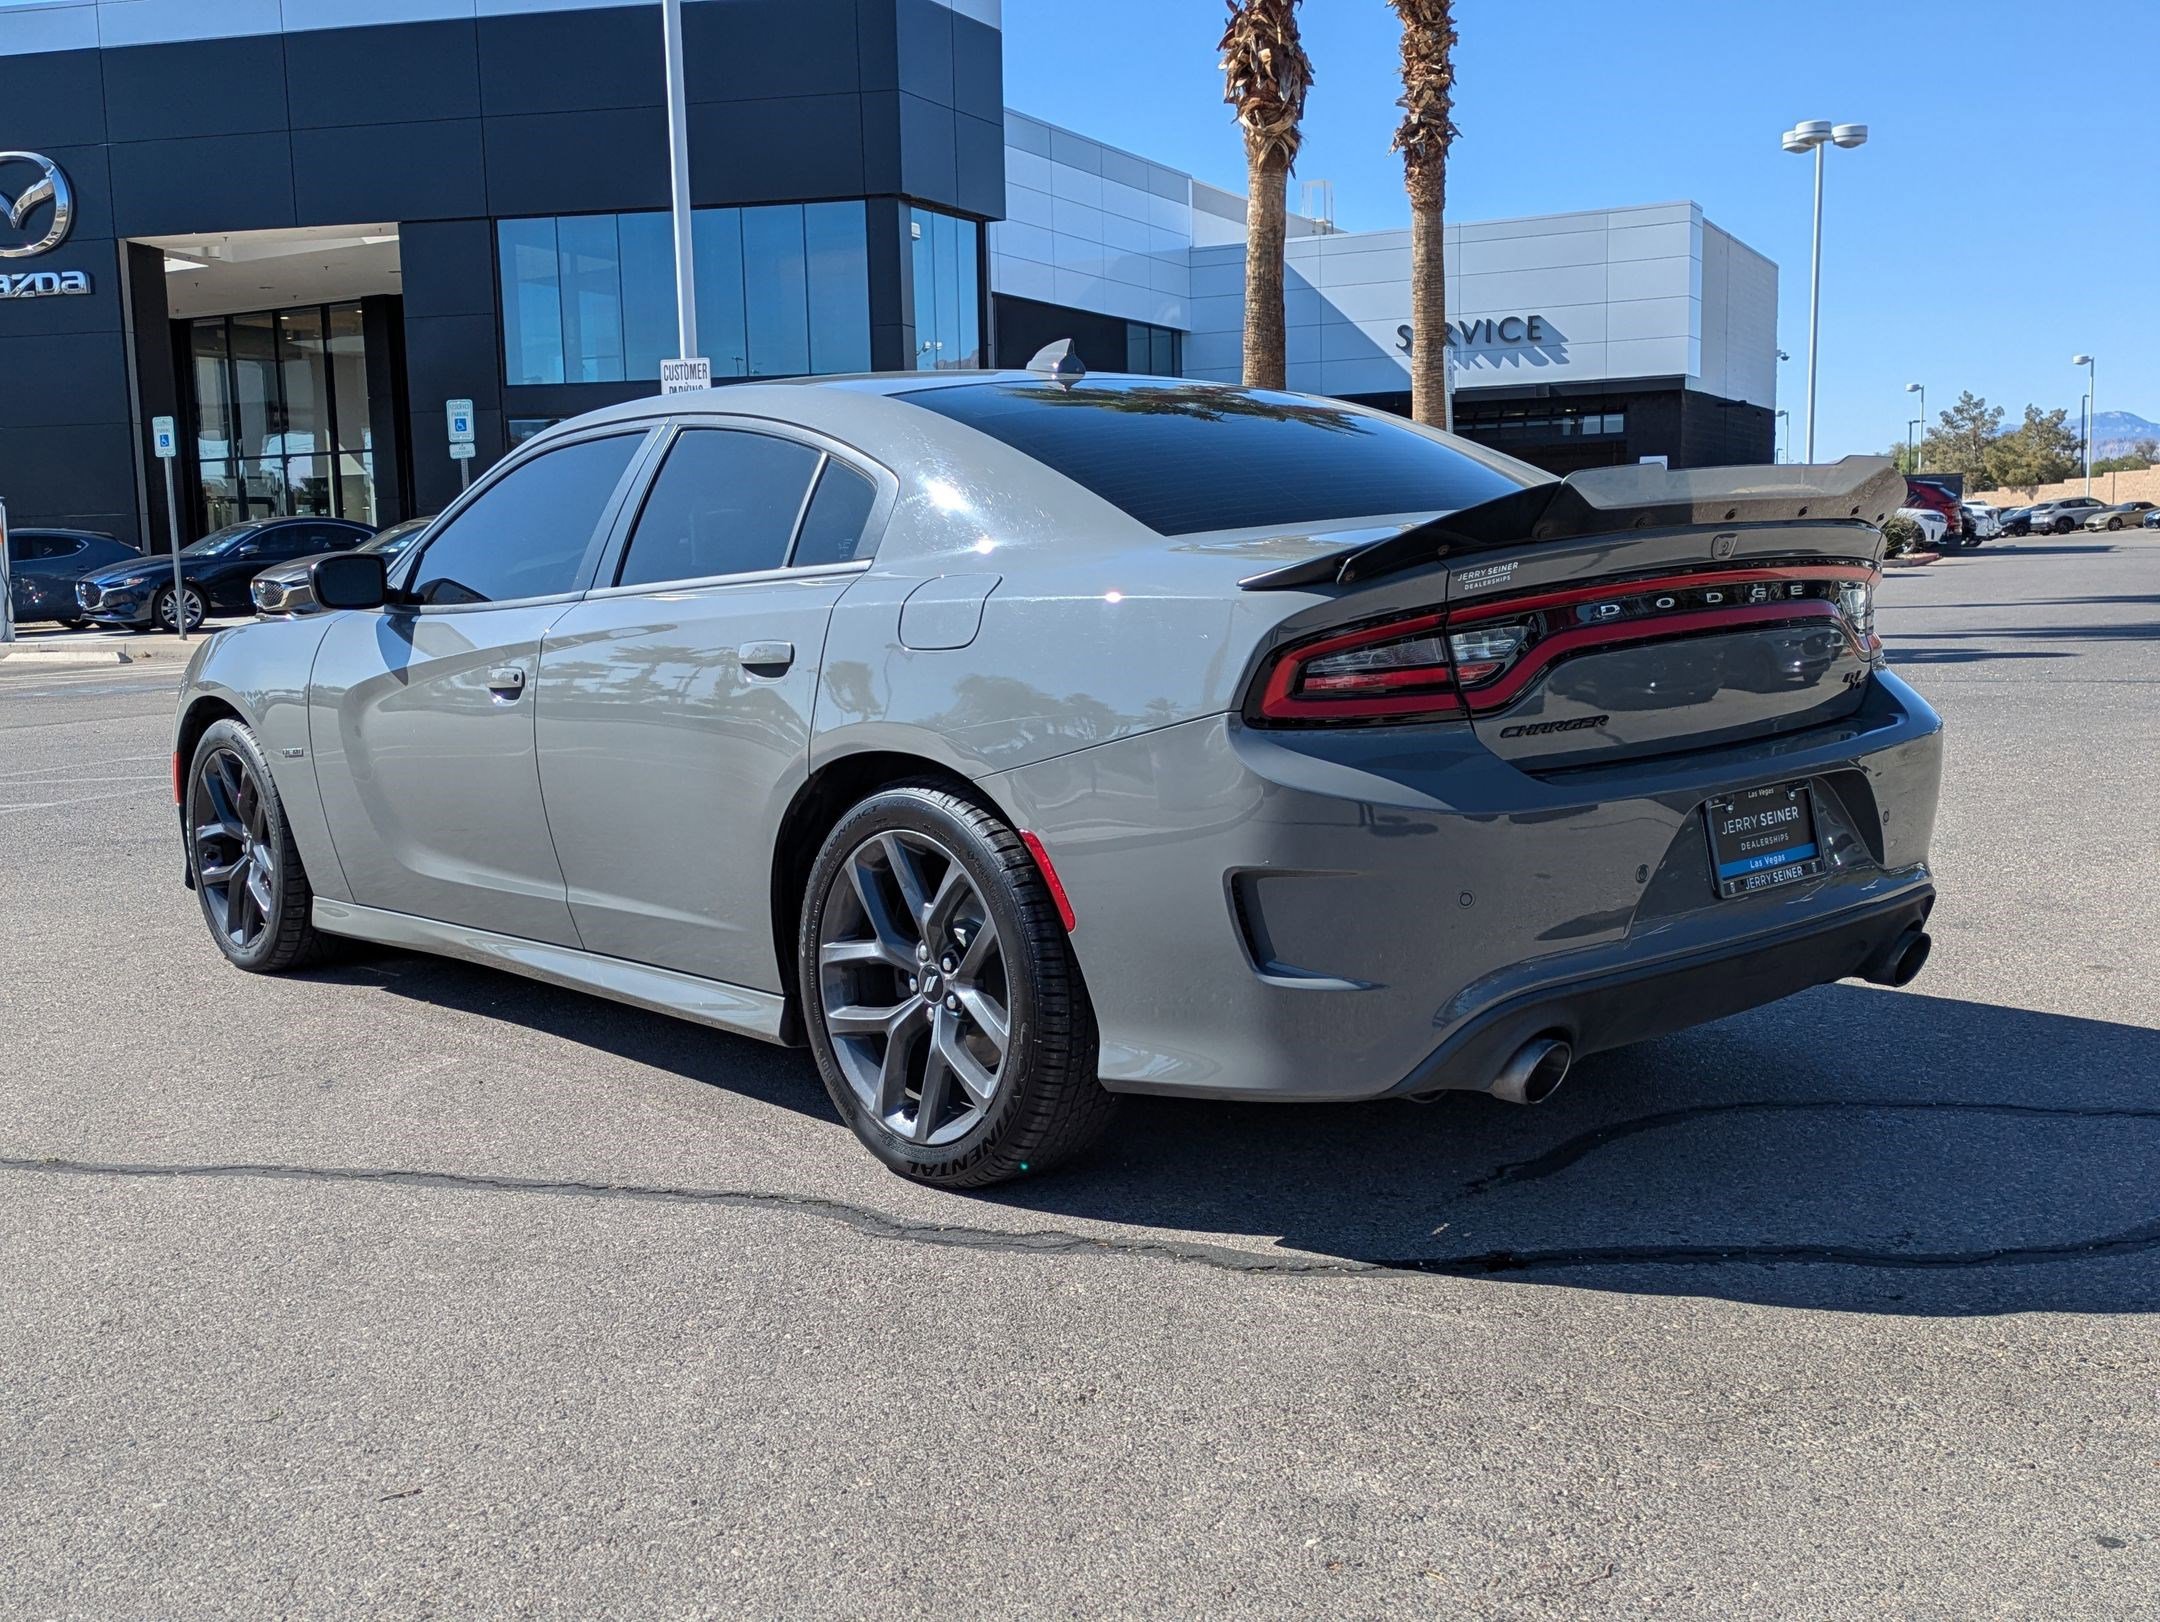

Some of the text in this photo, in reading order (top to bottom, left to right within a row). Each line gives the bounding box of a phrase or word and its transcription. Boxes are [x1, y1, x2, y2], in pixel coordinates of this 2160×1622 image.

[1396, 315, 1542, 351] SRVICE
[663, 362, 708, 382] CUSTOMER
[1457, 561, 1519, 582] JERRY SEINER
[1464, 575, 1511, 591] DEALERSHIPS
[1600, 584, 1804, 617] DODGE
[1499, 714, 1610, 739] CHARGER
[1748, 787, 1774, 799] Las Vegas
[1722, 806, 1799, 835] JERRY SEINER
[1741, 832, 1789, 851] DEALERSHIPS
[1749, 854, 1786, 869] Las Vegas
[1745, 865, 1804, 890] JERRY SEINER
